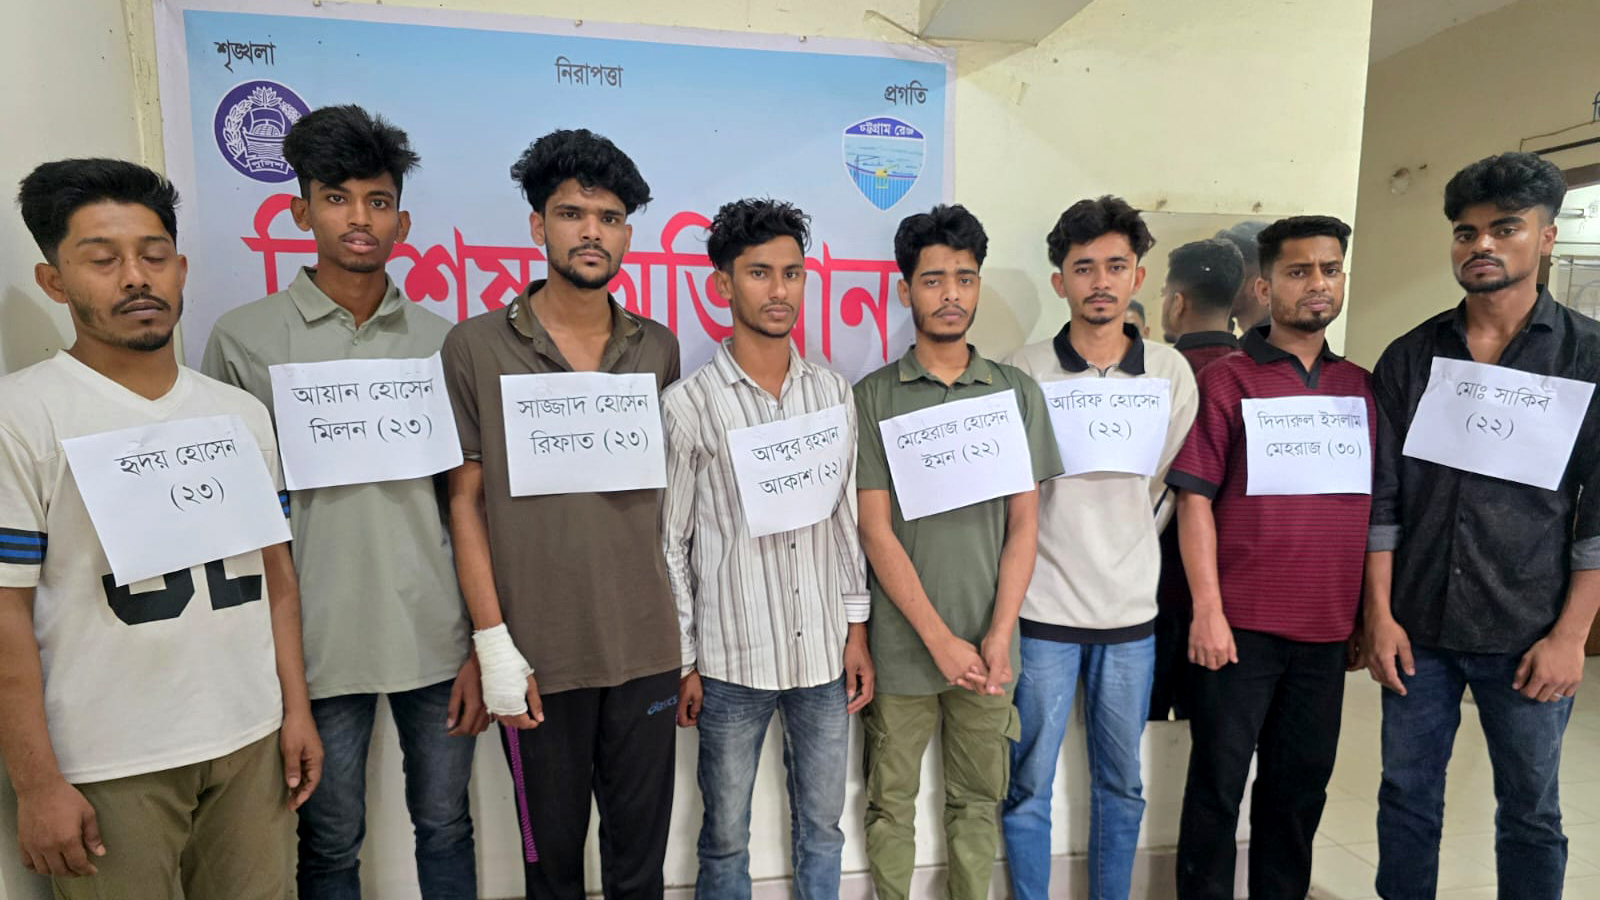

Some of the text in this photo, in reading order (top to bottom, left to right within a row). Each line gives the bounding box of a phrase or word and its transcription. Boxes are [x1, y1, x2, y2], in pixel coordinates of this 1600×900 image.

[214, 39, 277, 73] শৃঙ্খলা
[554, 55, 624, 88] নিরাপত্তা
[884, 80, 928, 106] প্রগতি
[291, 378, 434, 405] আয়ান হোসেন
[1048, 389, 1160, 410] আরিফ হোসেন
[1456, 381, 1552, 412] মোঃ সাকিব
[517, 394, 648, 418] সাজ্জাদ হোসেন
[1257, 410, 1362, 428] দিদারুল ইসলাম
[309, 414, 432, 443] মিলন (২৩)
[897, 410, 1009, 449] মেহেরাজ হোসেন
[1088, 419, 1132, 440] (২২)
[1465, 412, 1514, 440] (২২)
[529, 427, 649, 455] রিফাত (২৩)
[751, 426, 839, 462] আব্দুর রহমান
[921, 439, 999, 469] ইমন (২২)
[1266, 440, 1361, 459] মেহরাজ (৩০)
[114, 439, 239, 476] হৃদয় হোসেন
[171, 477, 224, 512] (২৩)
[758, 469, 814, 494] আকাশ
